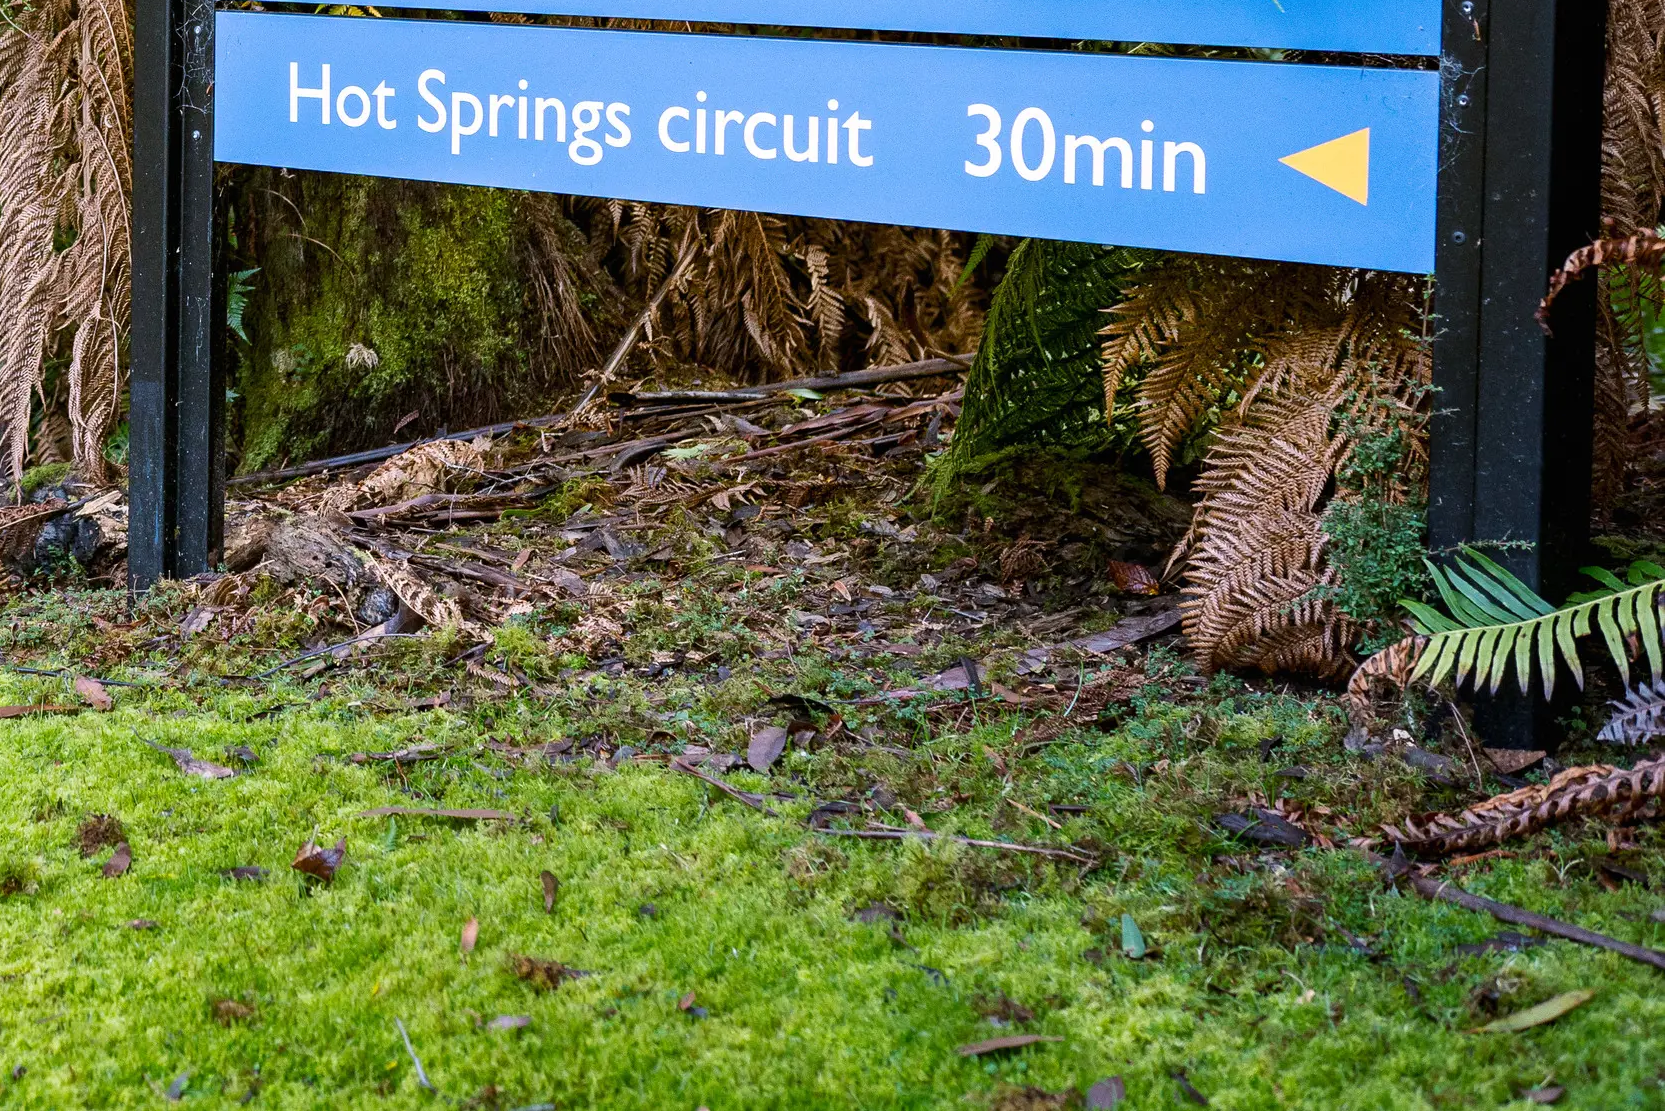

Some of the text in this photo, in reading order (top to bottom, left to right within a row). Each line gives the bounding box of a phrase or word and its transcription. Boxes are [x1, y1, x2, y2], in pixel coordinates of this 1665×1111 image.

[289, 61, 1206, 194] Hot Springs circuit 30min
